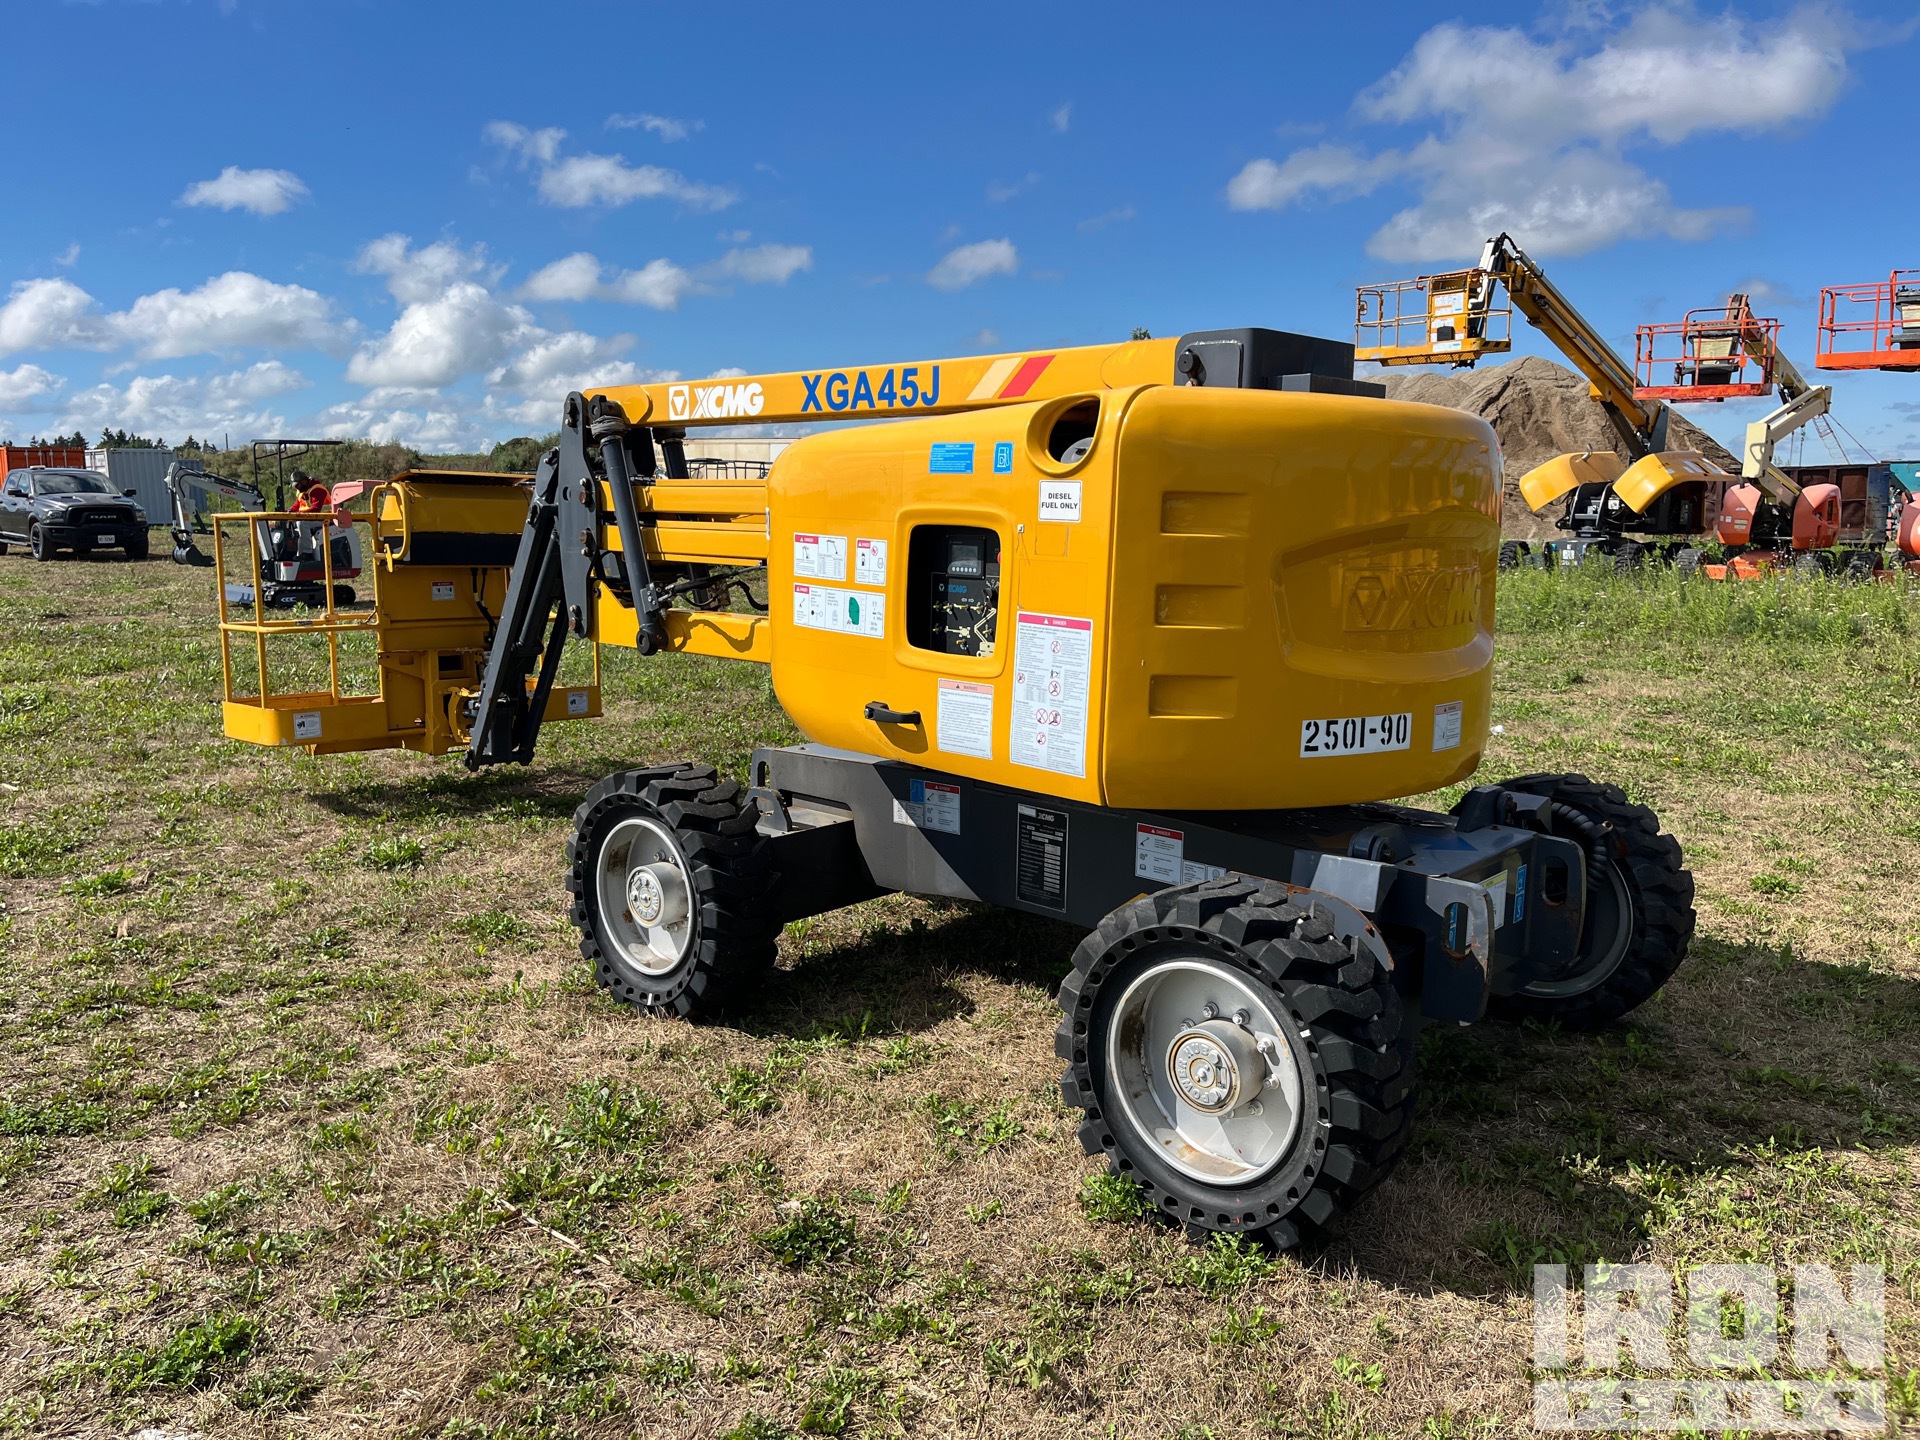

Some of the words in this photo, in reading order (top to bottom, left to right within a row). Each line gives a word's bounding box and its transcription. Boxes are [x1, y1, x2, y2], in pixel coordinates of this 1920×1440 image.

[691, 383, 764, 419] XCMG
[801, 366, 940, 413] XGA45J
[1041, 501, 1058, 509] FUEL
[1059, 502, 1078, 510] ONLY
[1047, 492, 1072, 500] DIESEL
[1304, 714, 1408, 752] 2501-90
[1183, 1042, 1210, 1060] HUB
[1177, 1058, 1210, 1104] POWER
